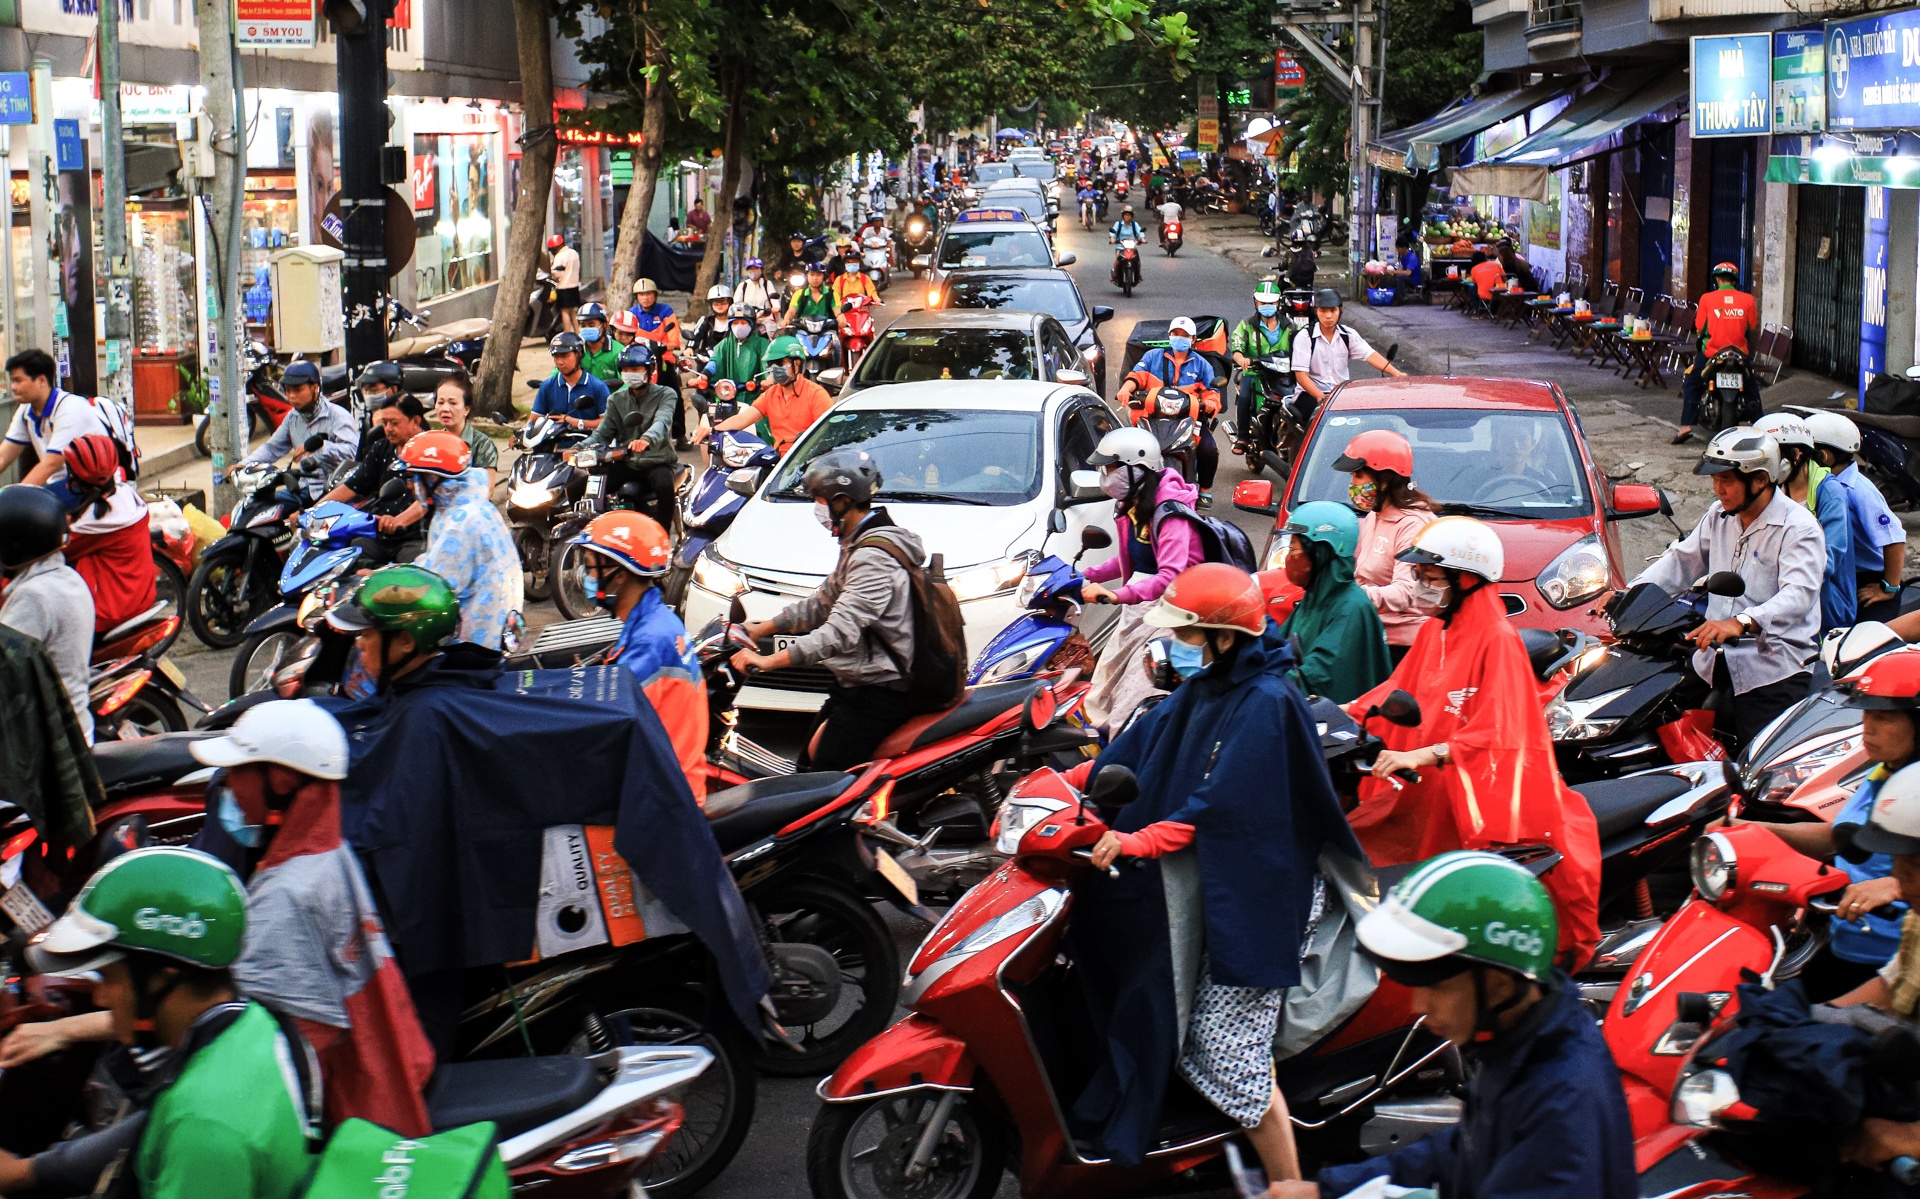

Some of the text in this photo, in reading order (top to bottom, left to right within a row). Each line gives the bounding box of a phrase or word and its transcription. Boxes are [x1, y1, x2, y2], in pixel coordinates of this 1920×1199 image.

[263, 27, 303, 37] SM YOU
[1863, 21, 1883, 57] THUỐC
[1719, 41, 1745, 78] NHÀ
[1698, 88, 1767, 130] THUỐC TÂY
[1864, 245, 1886, 327] THUỐC
[271, 532, 292, 545] YAMAHA
[1451, 548, 1490, 564] SUSEN
[1818, 797, 1846, 810] HONDA
[568, 834, 590, 891] QUALITY
[1483, 921, 1544, 956] Grab
